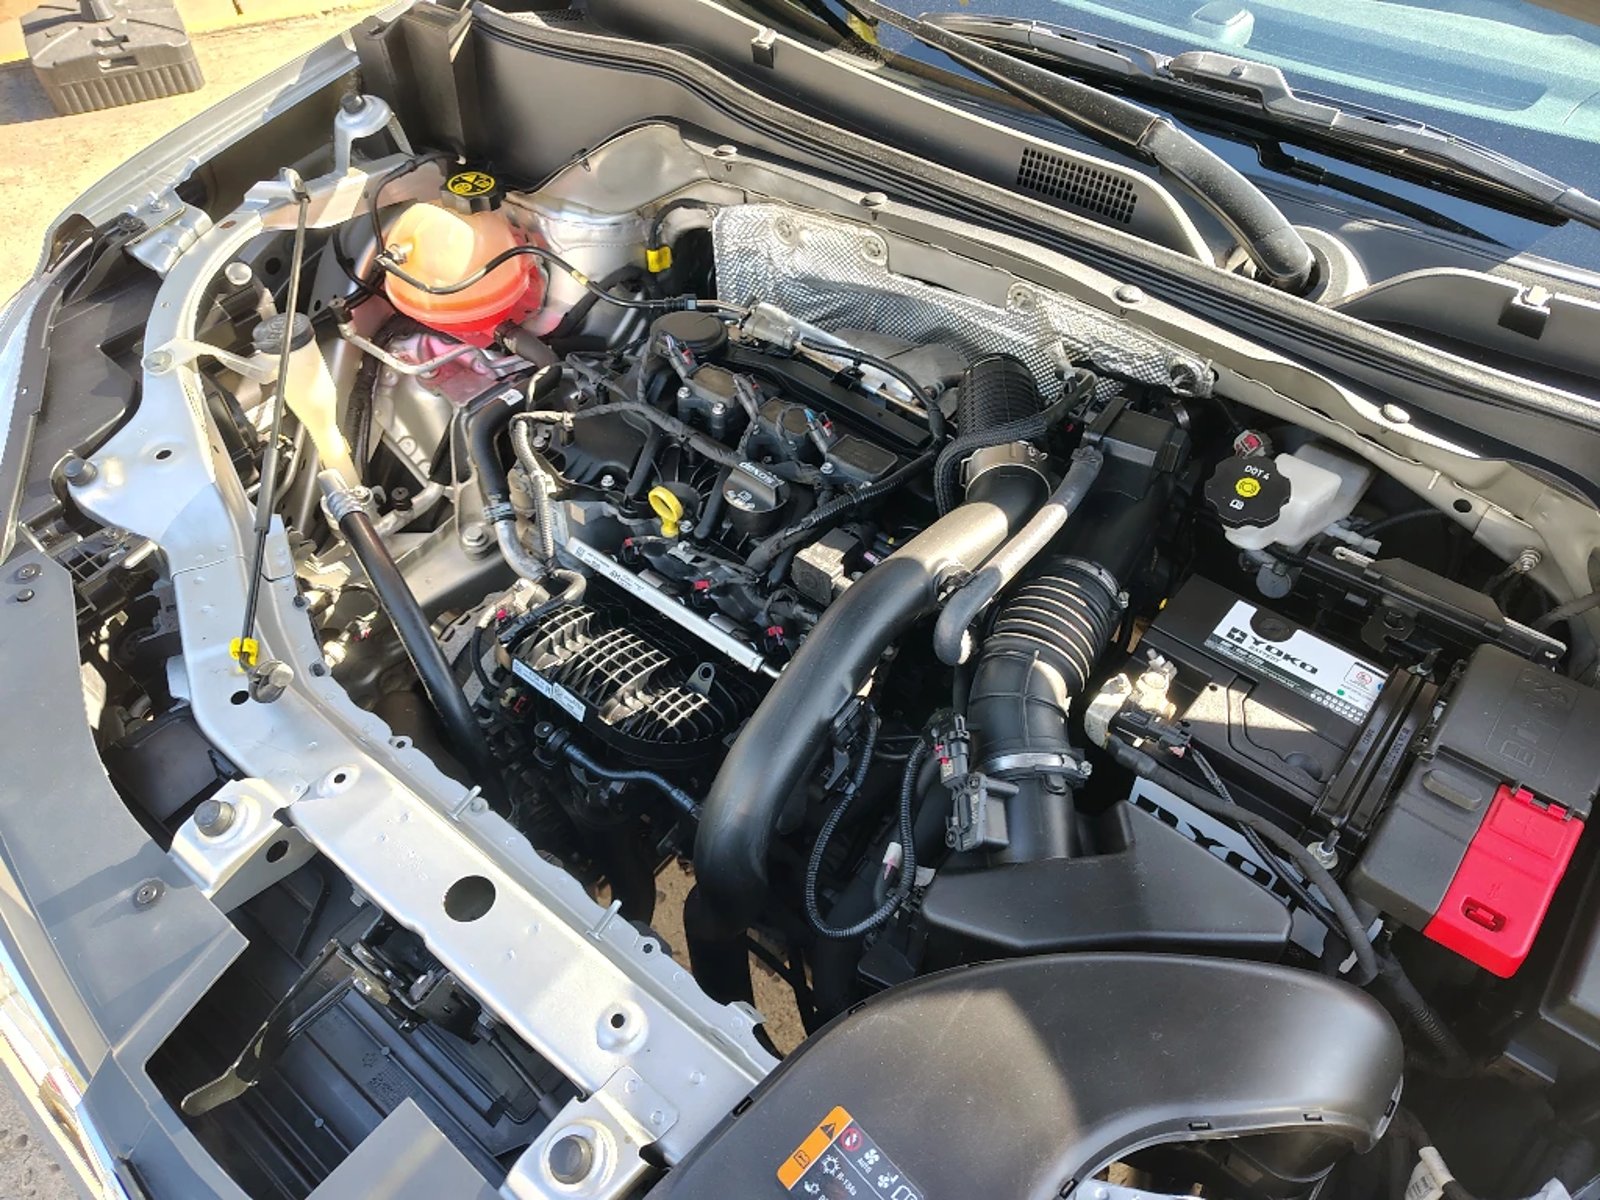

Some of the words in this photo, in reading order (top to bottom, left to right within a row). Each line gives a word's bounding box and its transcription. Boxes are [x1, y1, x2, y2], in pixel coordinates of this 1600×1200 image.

[1244, 465, 1264, 477] DOT
[1262, 472, 1270, 480] 4
[1250, 635, 1318, 674] YOKO
